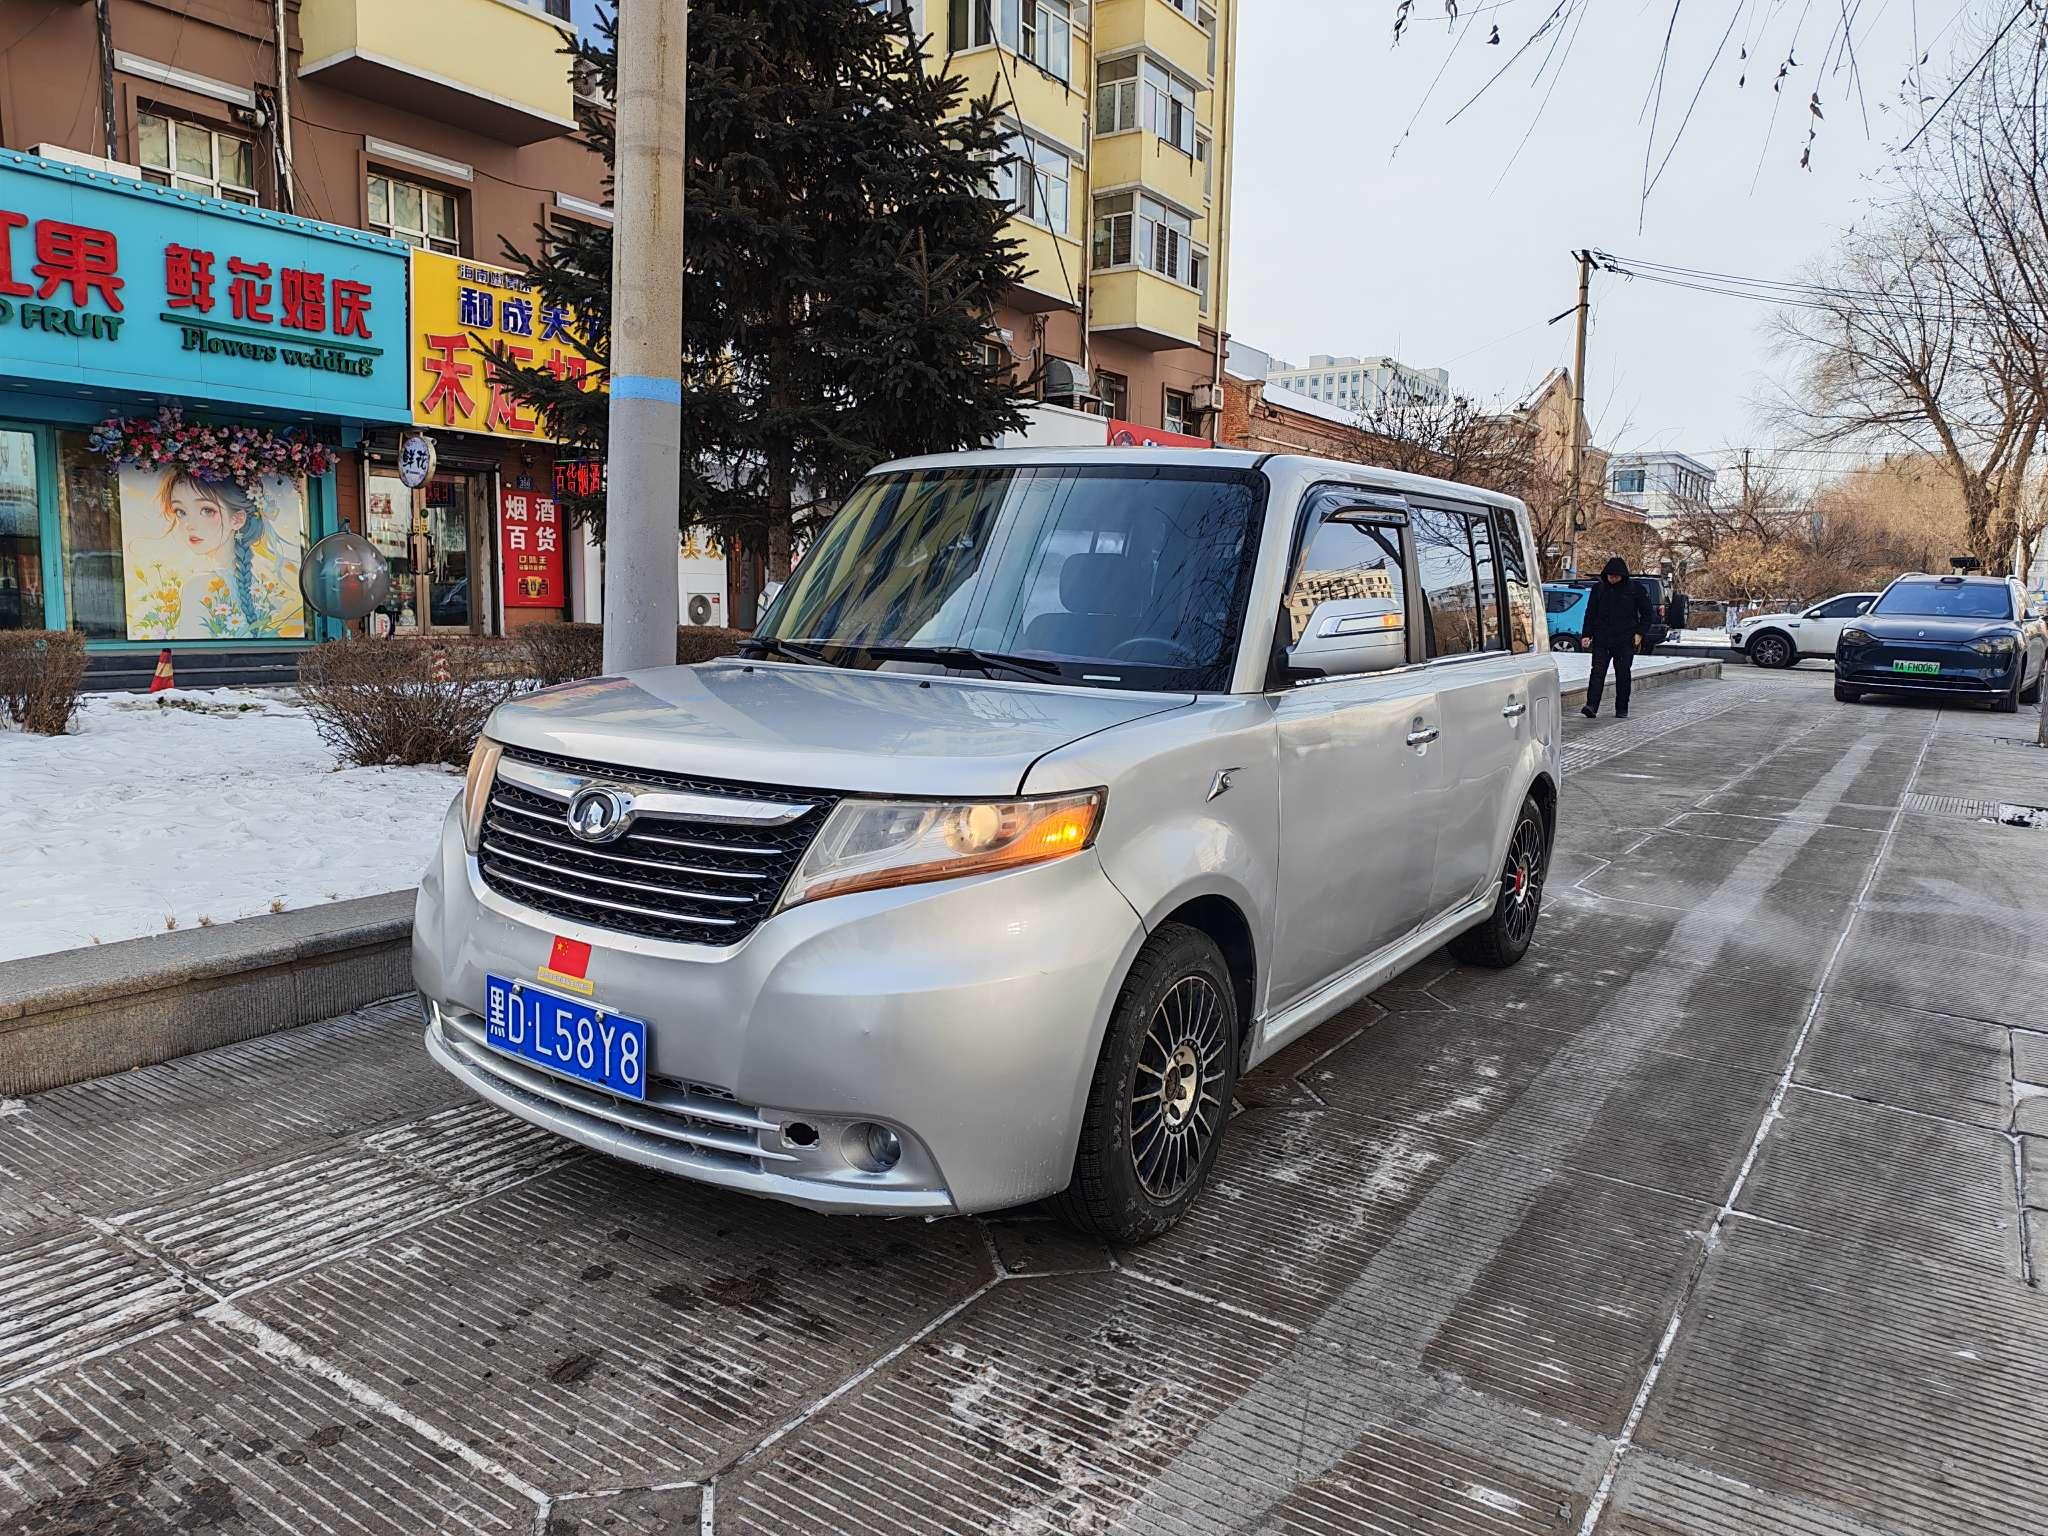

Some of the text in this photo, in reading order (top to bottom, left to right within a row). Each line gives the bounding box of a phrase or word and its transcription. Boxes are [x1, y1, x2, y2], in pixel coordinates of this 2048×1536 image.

[164, 243, 373, 338] 鲜花婚庆
[21, 303, 125, 341] FRUIT
[181, 327, 374, 376] Flowers wedding
[403, 448, 427, 470] 鲜花
[505, 494, 555, 523] 烟酒
[506, 525, 556, 551] 百货
